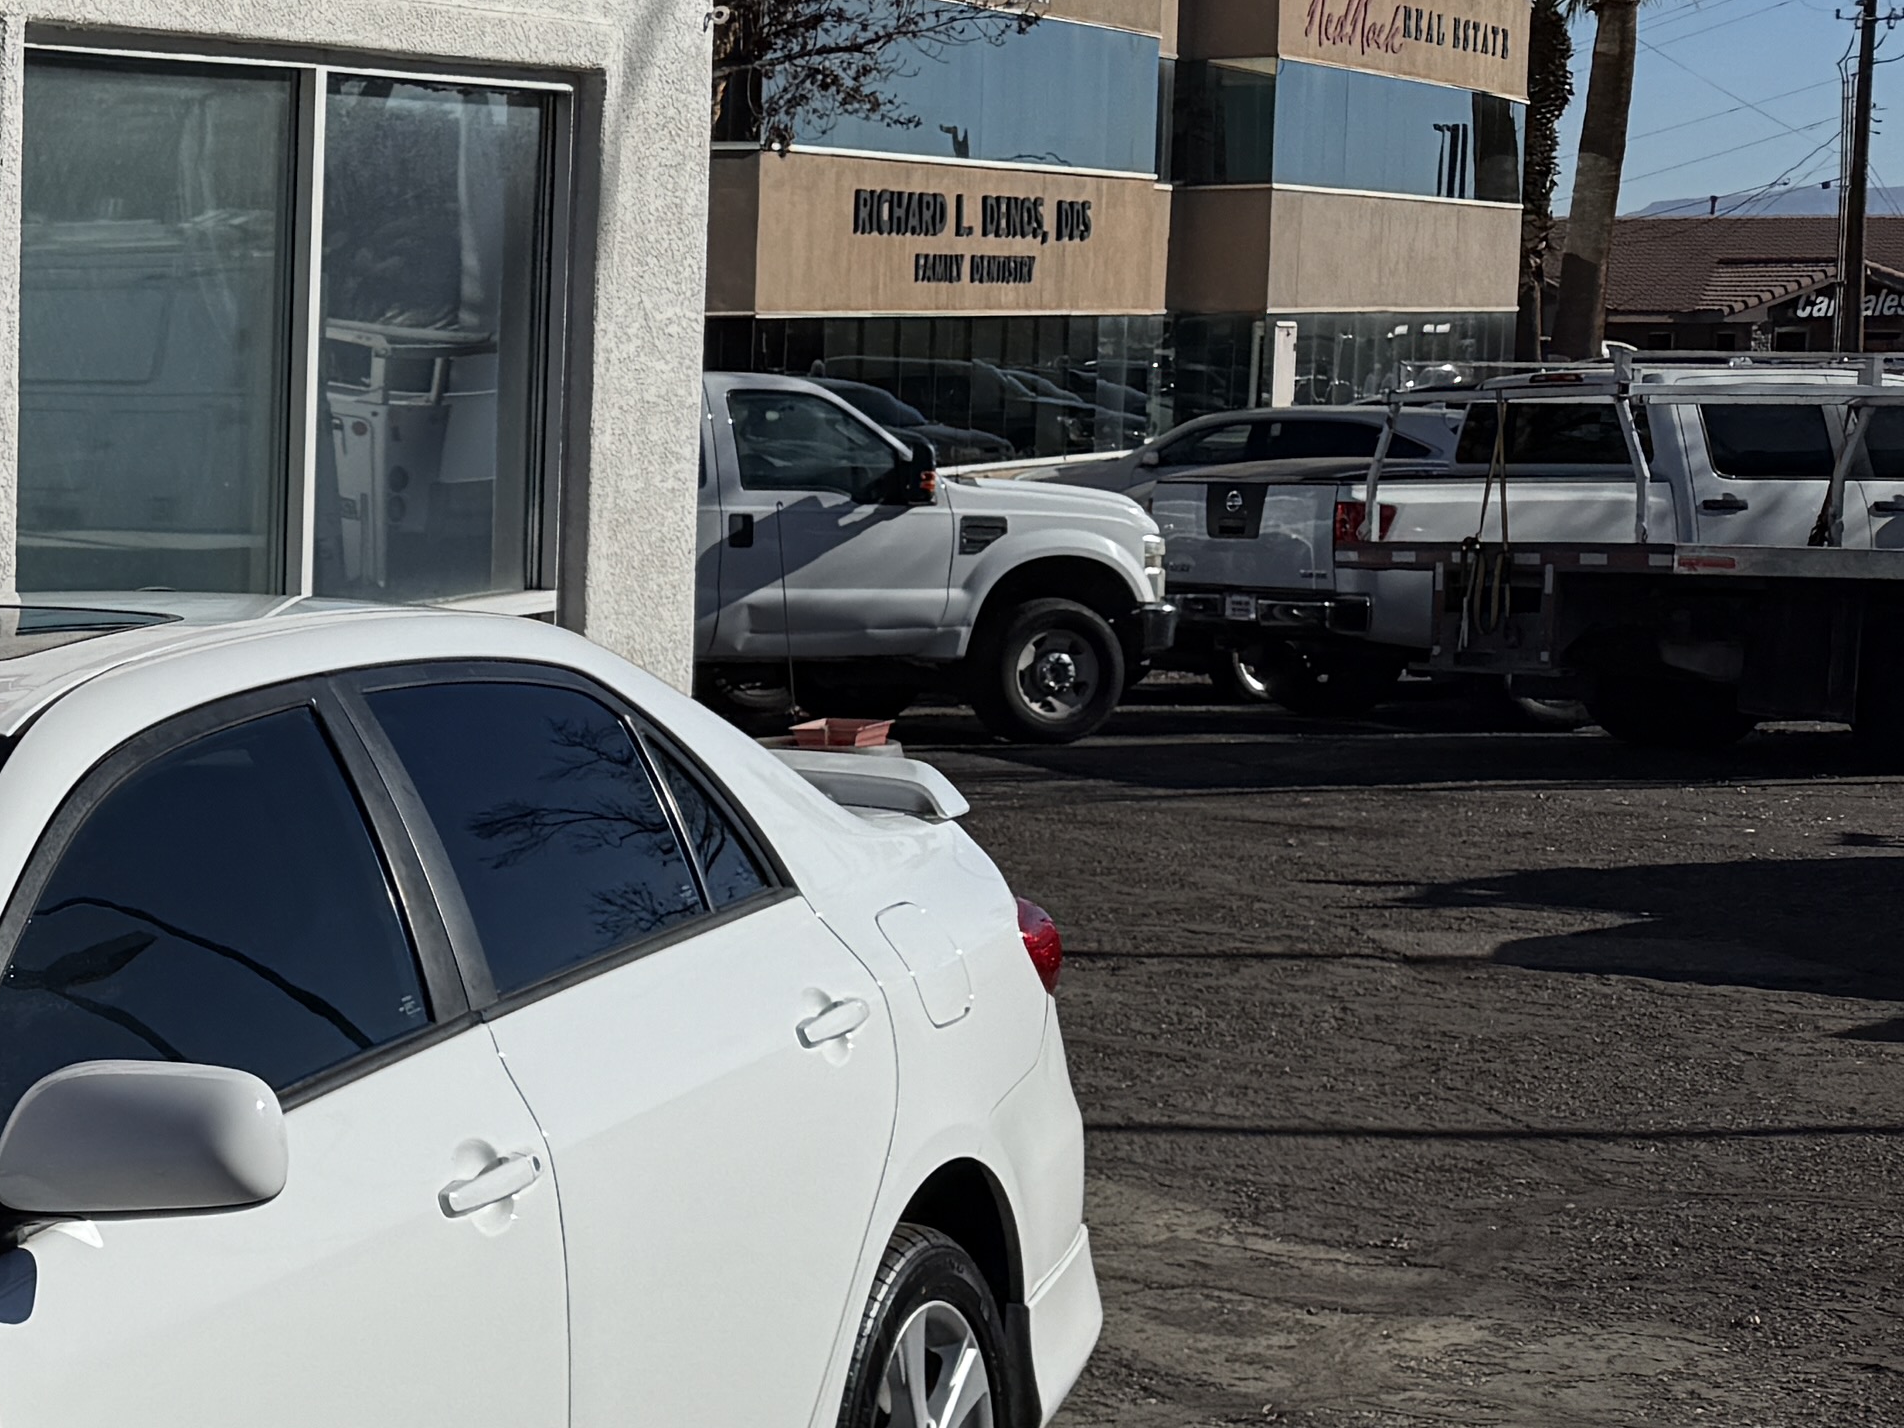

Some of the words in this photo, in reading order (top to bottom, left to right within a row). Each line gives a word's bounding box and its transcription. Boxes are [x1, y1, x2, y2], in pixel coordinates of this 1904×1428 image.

[1402, 5, 1446, 46] REAL
[1452, 17, 1510, 59] ESTATE
[853, 188, 949, 237] RICHARD
[954, 193, 975, 238] L.
[1055, 199, 1093, 242] DDS
[914, 253, 966, 283] FAMILY
[969, 254, 1037, 284] DENTISTRY
